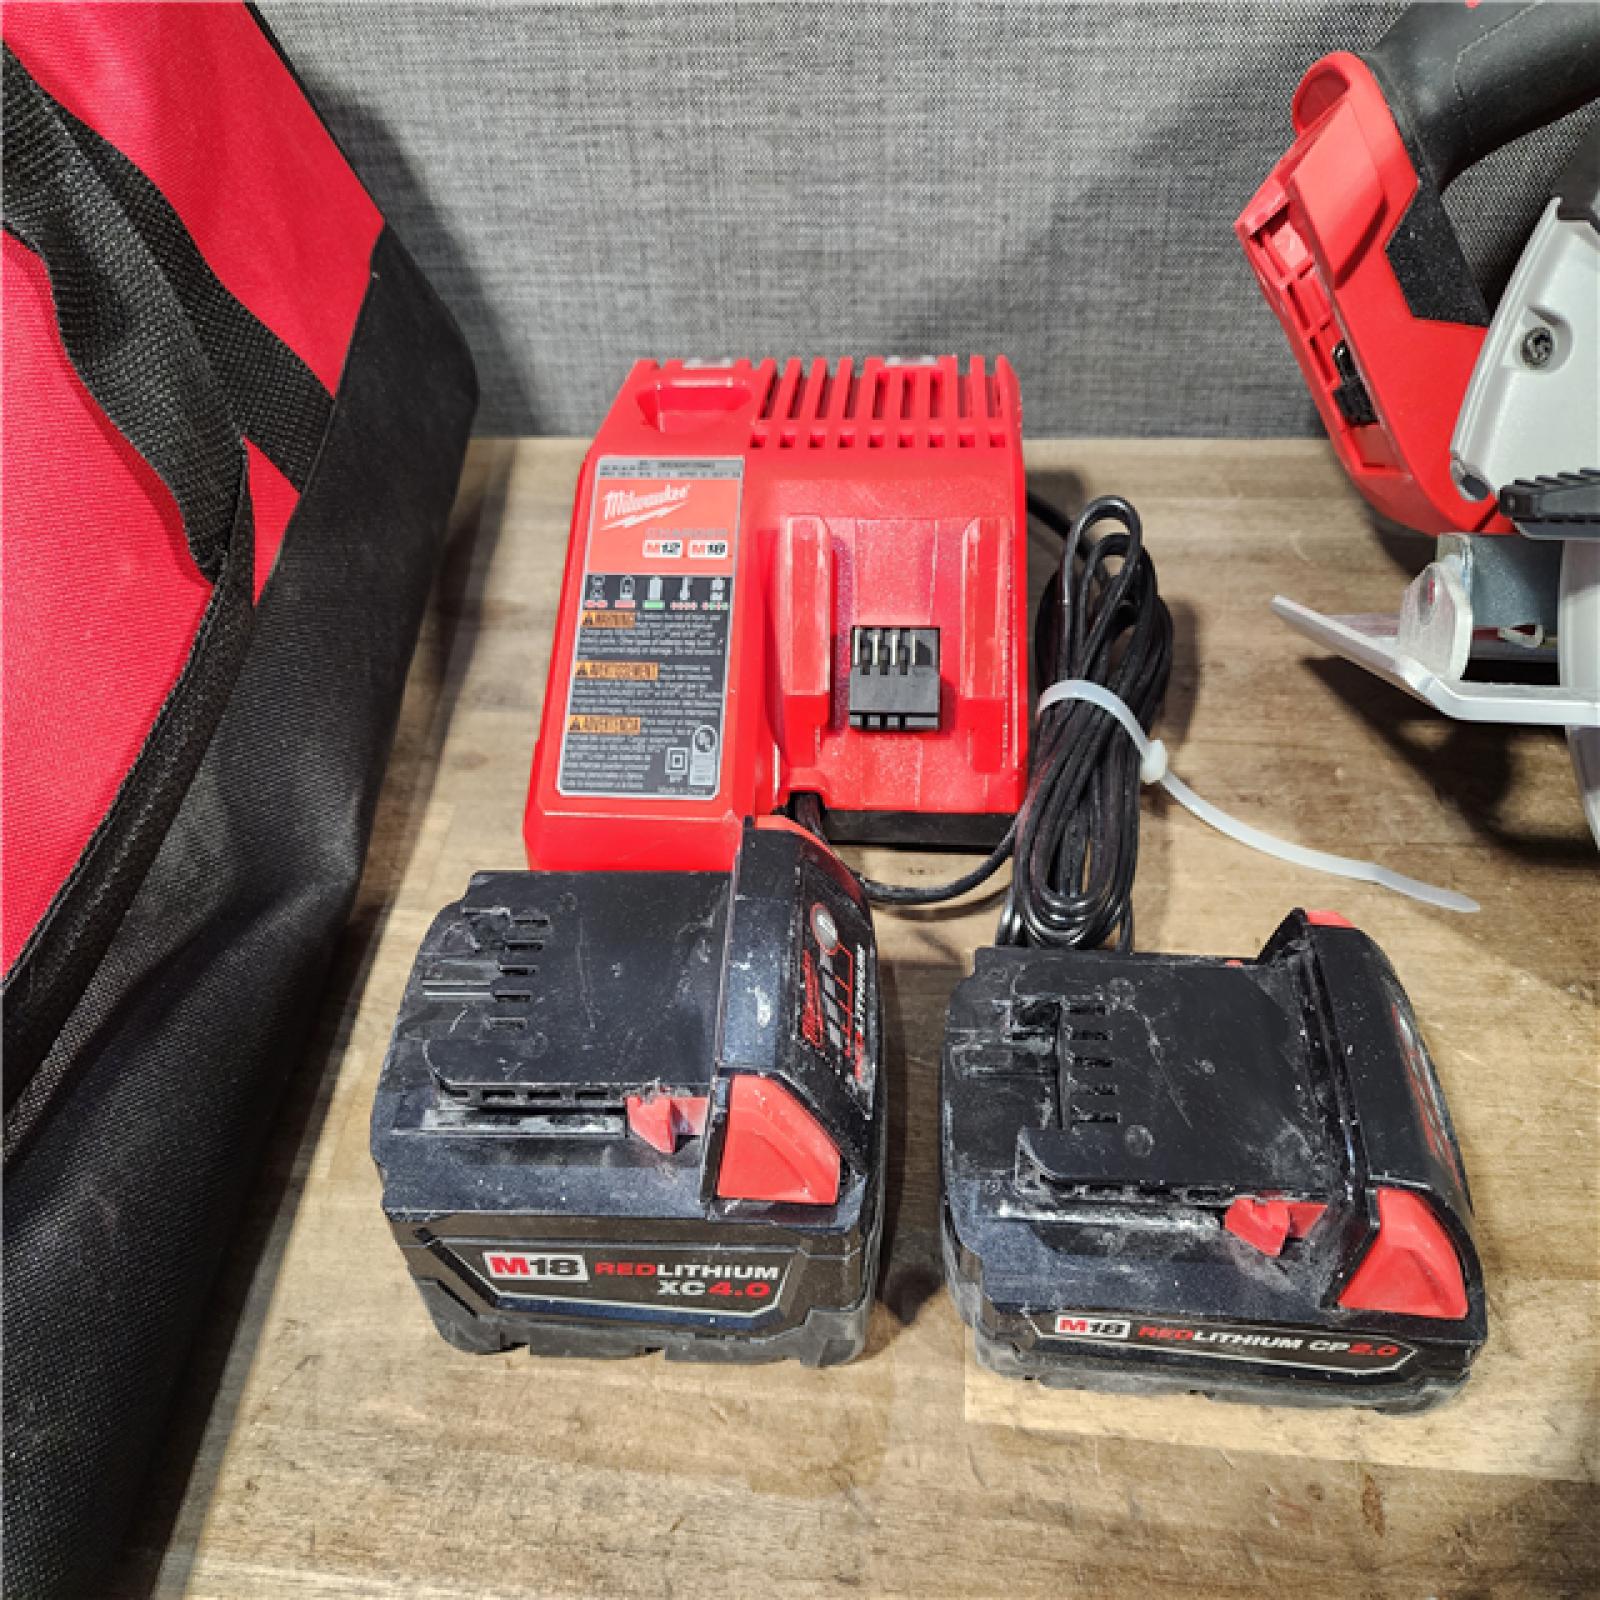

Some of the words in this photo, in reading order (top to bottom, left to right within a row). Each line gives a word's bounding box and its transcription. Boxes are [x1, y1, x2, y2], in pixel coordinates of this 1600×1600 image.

[489, 1256, 582, 1275] M18
[594, 1261, 779, 1280] REDLITHIUM
[1059, 1319, 1125, 1334] M18
[1138, 1326, 1304, 1350] REDLITHIUM
